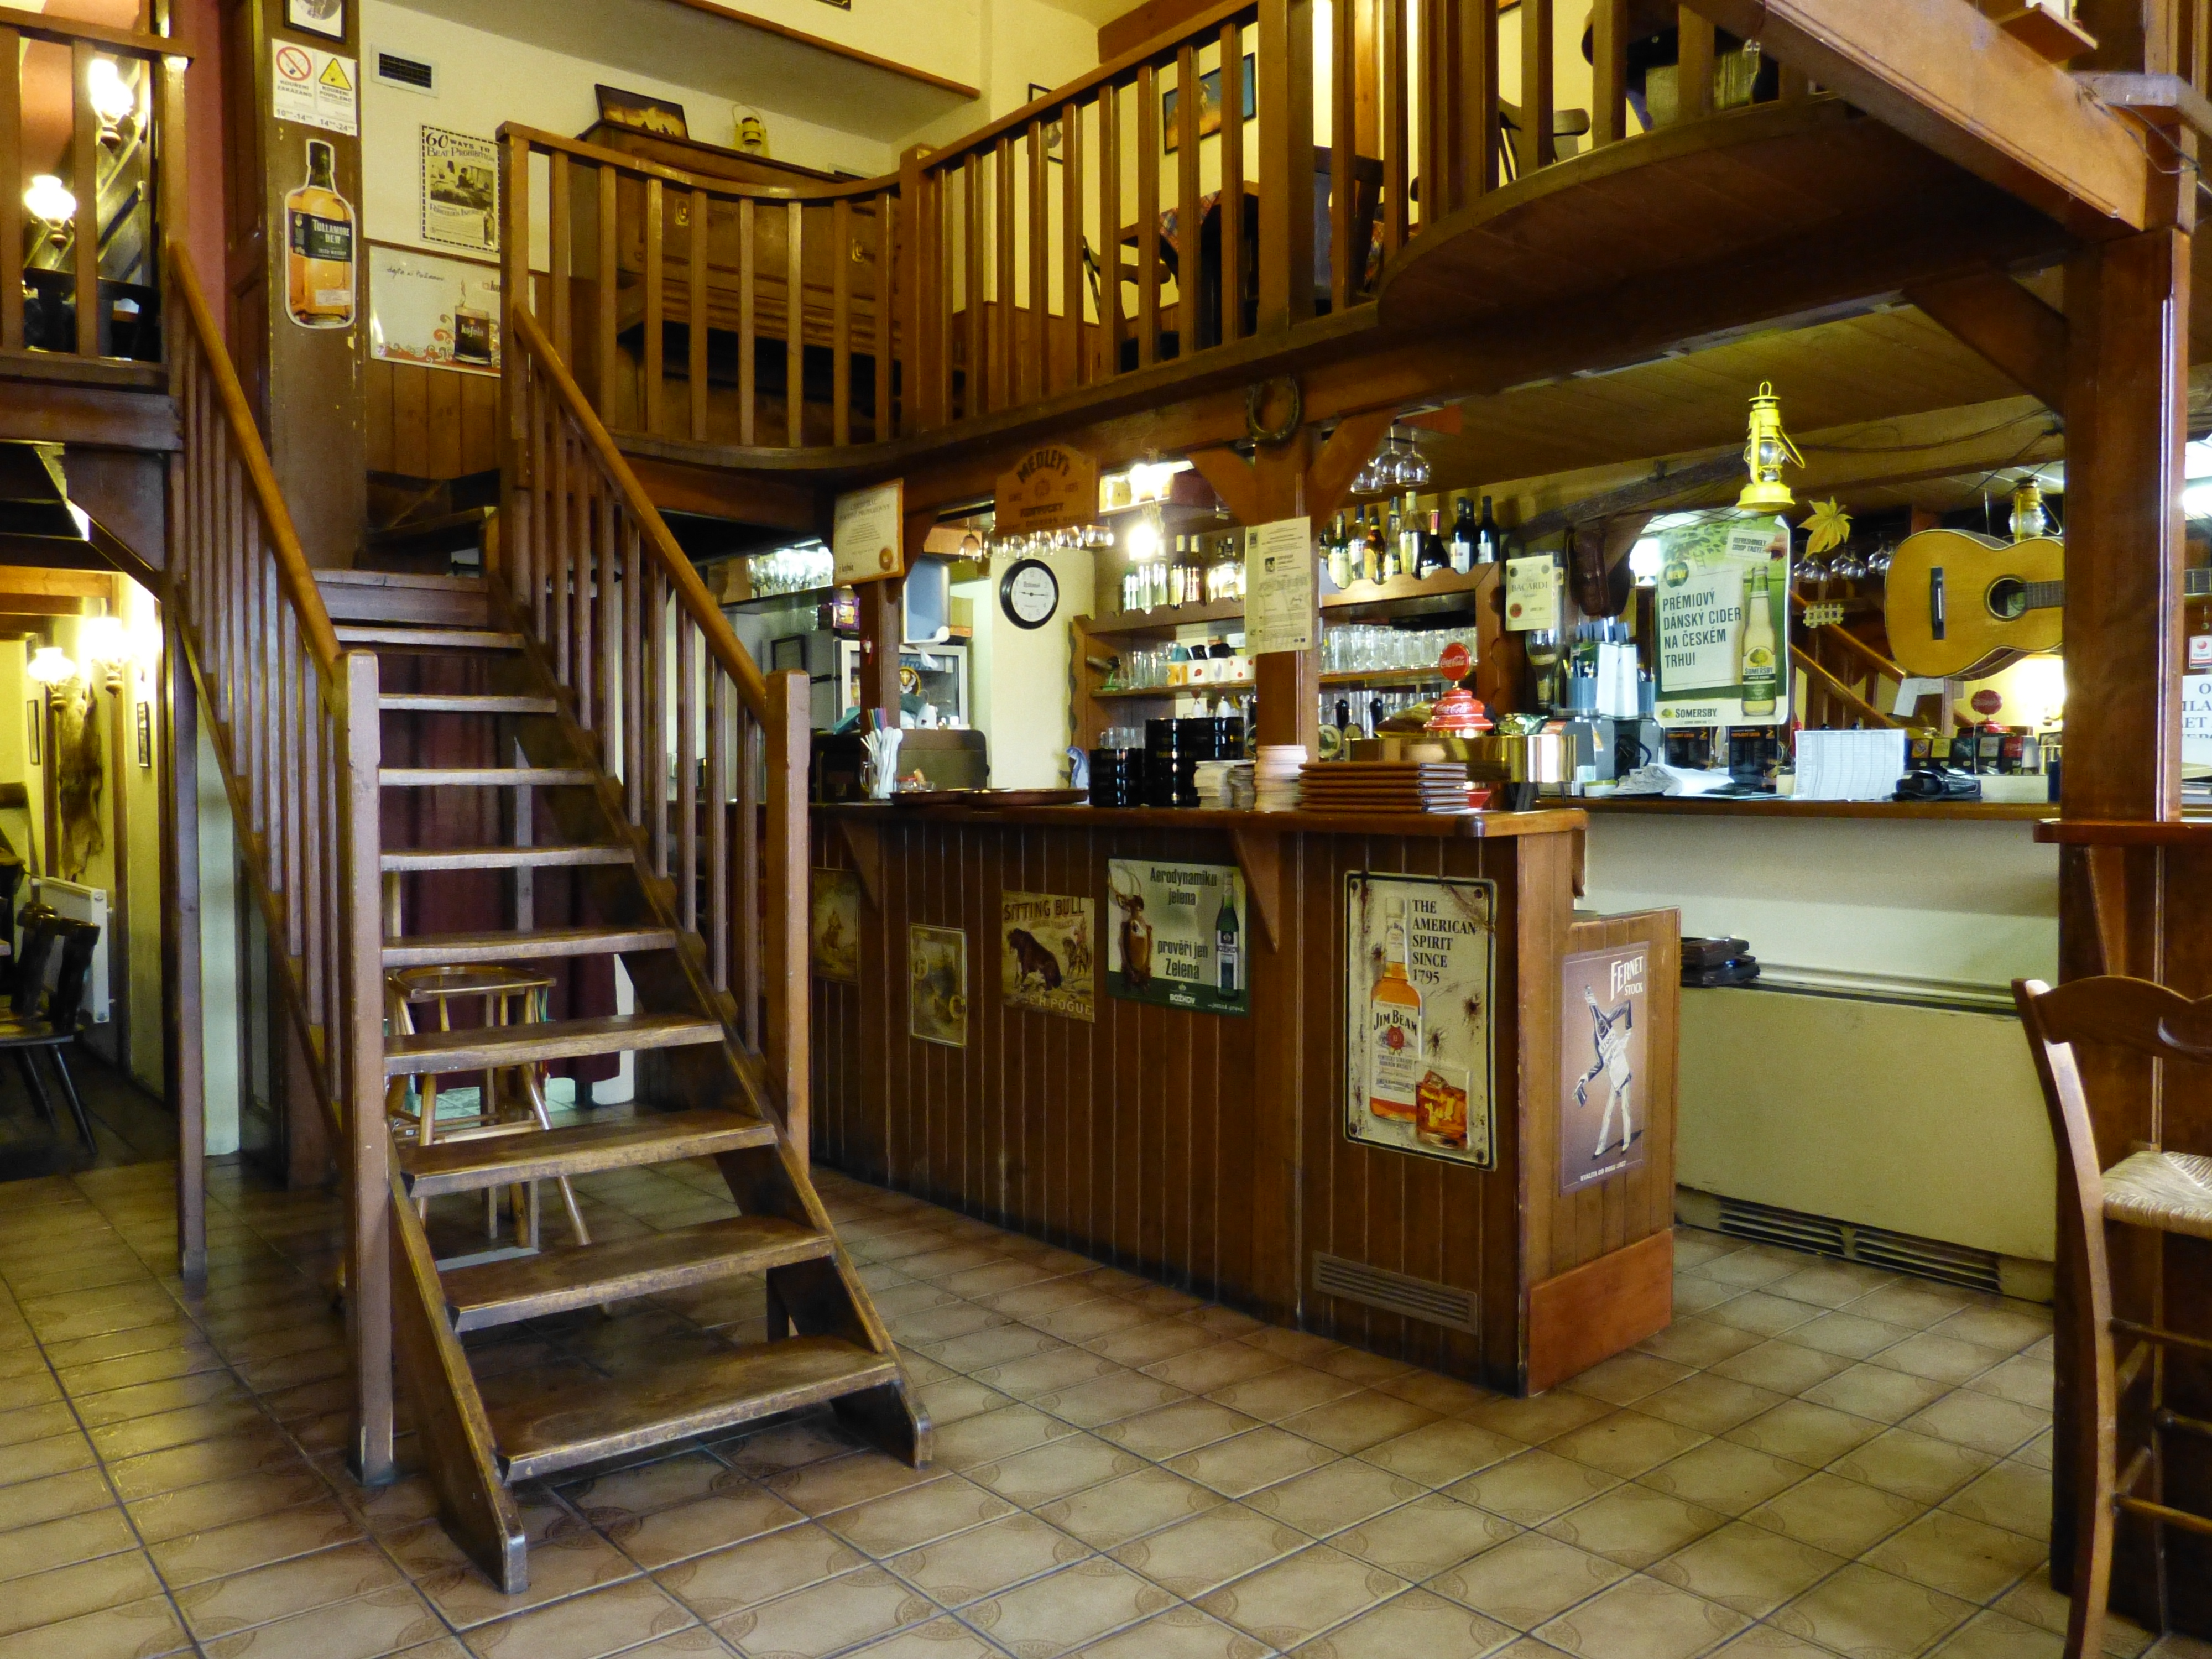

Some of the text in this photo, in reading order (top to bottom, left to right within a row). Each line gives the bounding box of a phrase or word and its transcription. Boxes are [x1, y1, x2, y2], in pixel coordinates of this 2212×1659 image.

[426, 132, 449, 149] 60
[450, 139, 474, 150] WAYS
[426, 146, 495, 163] BEAT PROHIBITION
[311, 218, 351, 237] TULLAMORE
[324, 233, 342, 244] DEW
[1666, 569, 1687, 581] NEW
[1511, 581, 1548, 592] BACARDI
[1662, 587, 1715, 612] PRÉMIOVÝ
[1663, 607, 1741, 631] DÁNSKÝ CIDER
[1665, 626, 1726, 650] NA ČESKÉM
[1664, 651, 1695, 669] TRHU!
[1674, 707, 1718, 719] SOMERSBY
[1150, 867, 1218, 887] Aerodynamiku
[1168, 887, 1197, 906] jelena
[1003, 896, 1085, 921] SITTING BULL
[1412, 899, 1437, 914] THE
[1412, 916, 1477, 936] AMERICAN
[1157, 939, 1208, 959] prověří jen
[1412, 934, 1454, 951] SPIRIT
[1412, 951, 1448, 968] SINCE
[1165, 958, 1200, 980] Zelená
[1413, 969, 1440, 985] 1795
[1610, 956, 1644, 1003] FERNET
[1624, 982, 1644, 996] STOCK
[1050, 998, 1093, 1016] POGUE
[1373, 1009, 1418, 1037] JIM BEAM
